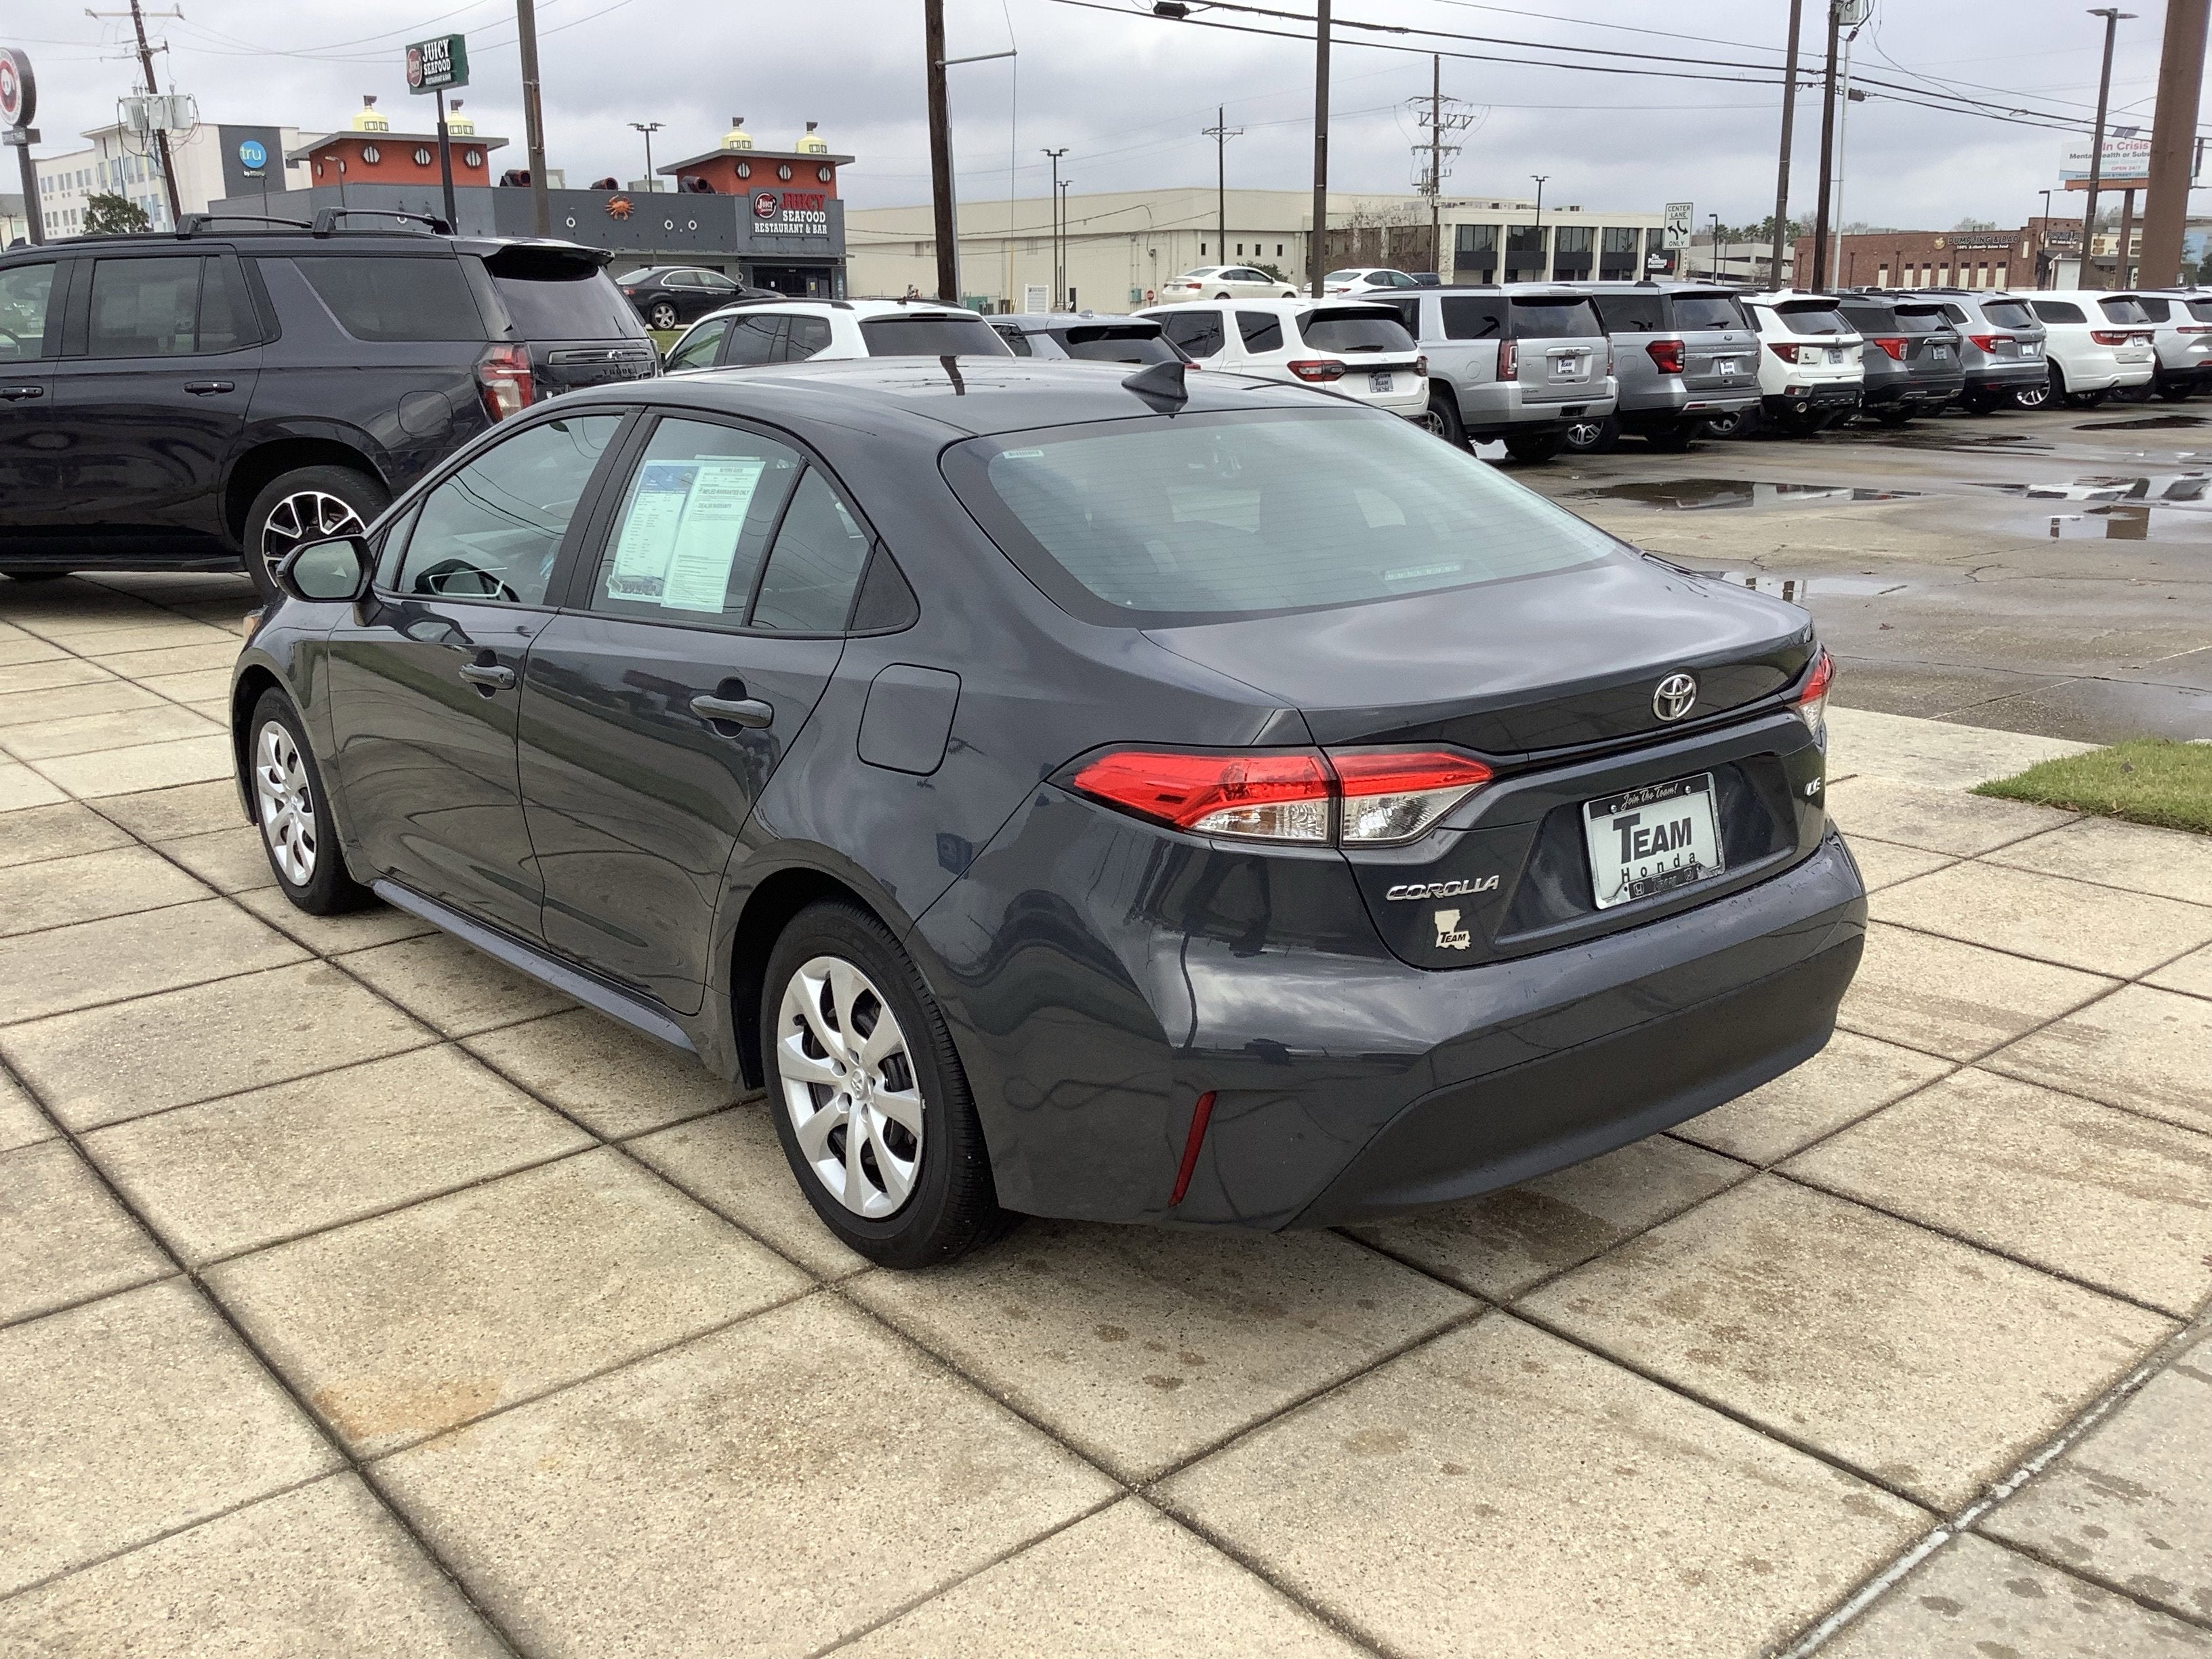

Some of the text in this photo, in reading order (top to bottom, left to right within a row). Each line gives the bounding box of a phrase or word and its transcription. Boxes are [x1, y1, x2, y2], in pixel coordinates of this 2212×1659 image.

[422, 39, 449, 62] JUICY
[423, 58, 451, 76] SEAFOOD
[240, 146, 262, 161] tru
[2103, 140, 2149, 150] In Crisis
[779, 192, 826, 211] JUICY
[782, 210, 826, 223] SEAFOOD
[754, 222, 827, 234] RESTAURANT & BAR
[1620, 783, 1679, 811] Join The Team!
[1612, 813, 1692, 865] TEAM
[1621, 852, 1696, 883] Honda
[1386, 875, 1500, 901] COROLLA
[1440, 931, 1467, 943] TEAM
